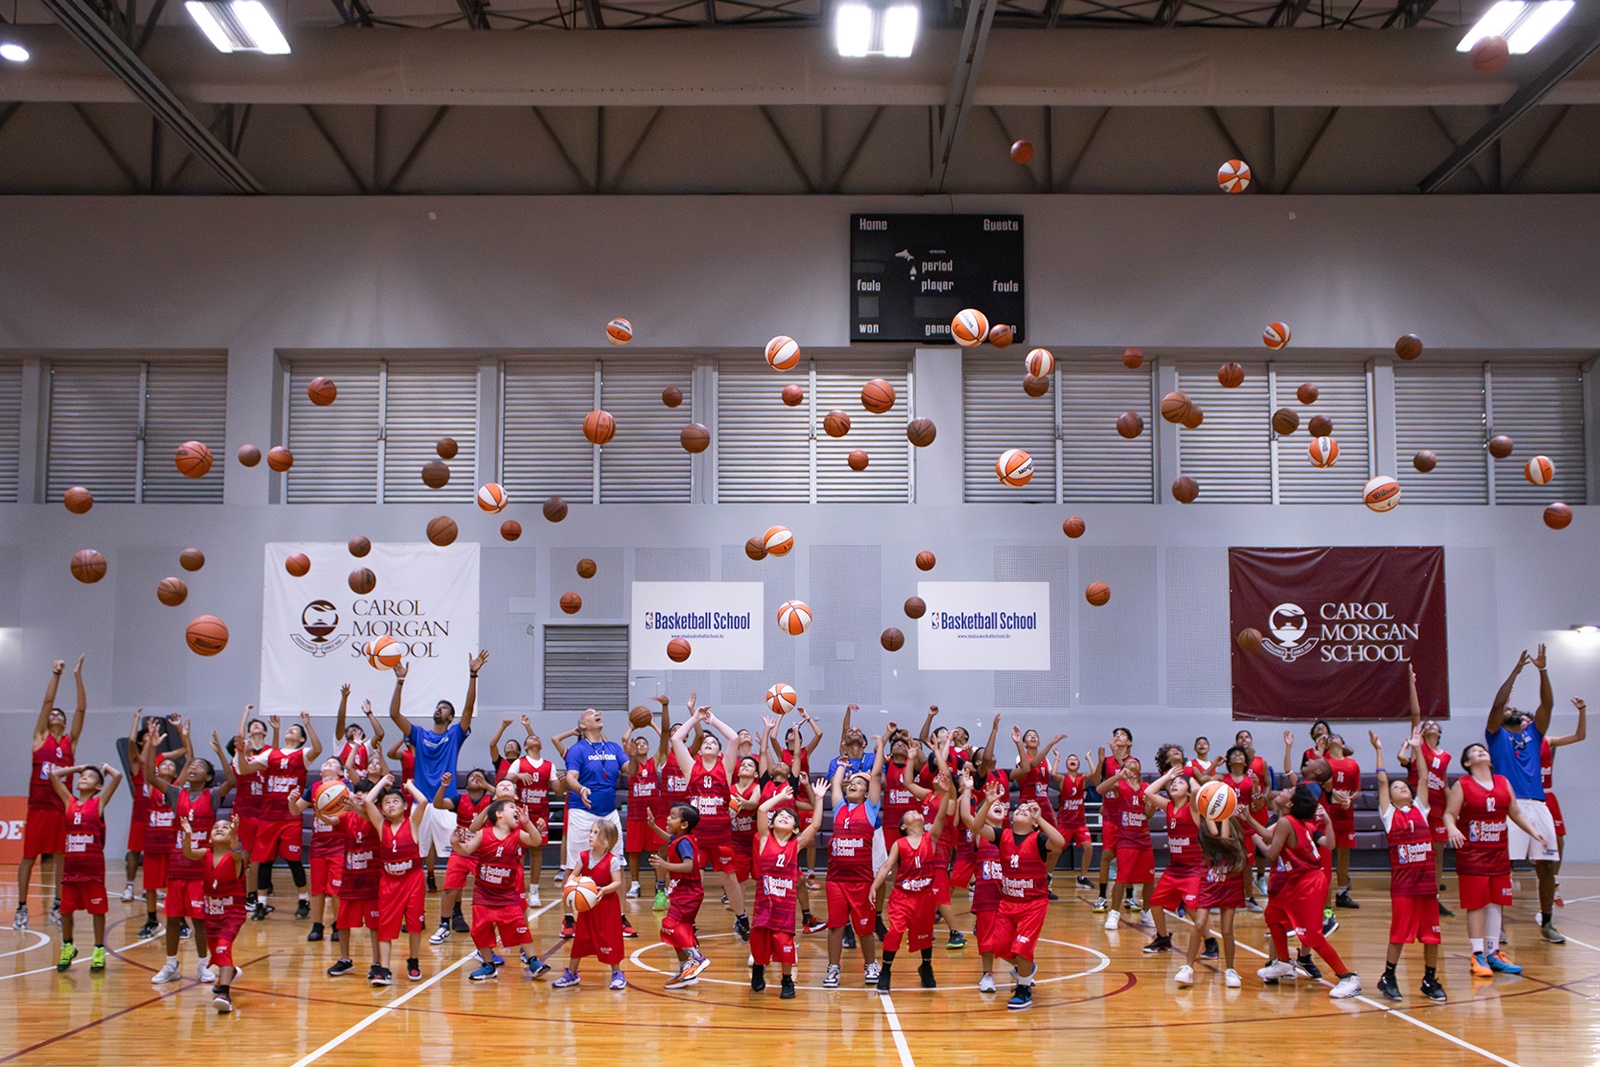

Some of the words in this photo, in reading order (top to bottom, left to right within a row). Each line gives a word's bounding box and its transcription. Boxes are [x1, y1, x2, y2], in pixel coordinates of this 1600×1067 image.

[859, 218, 888, 230] Home
[983, 218, 1018, 231] Guests
[922, 260, 953, 274] period
[857, 279, 880, 291] fouls
[921, 279, 954, 292] player
[992, 280, 1018, 292] fouls
[859, 324, 879, 333] won
[925, 324, 950, 336] game
[352, 599, 426, 616] CAROL
[1320, 602, 1394, 620] CAROL
[654, 612, 711, 629] Basketball
[714, 612, 750, 629] School
[941, 612, 997, 629] Basketball
[1000, 612, 1036, 629] School
[352, 620, 450, 637] MORGAN
[1320, 624, 1420, 641] MORGAN
[351, 642, 439, 658] SOOL
[1320, 644, 1410, 662] SCHOOL
[1209, 792, 1225, 815] Wilson
[776, 854, 785, 867] 22
